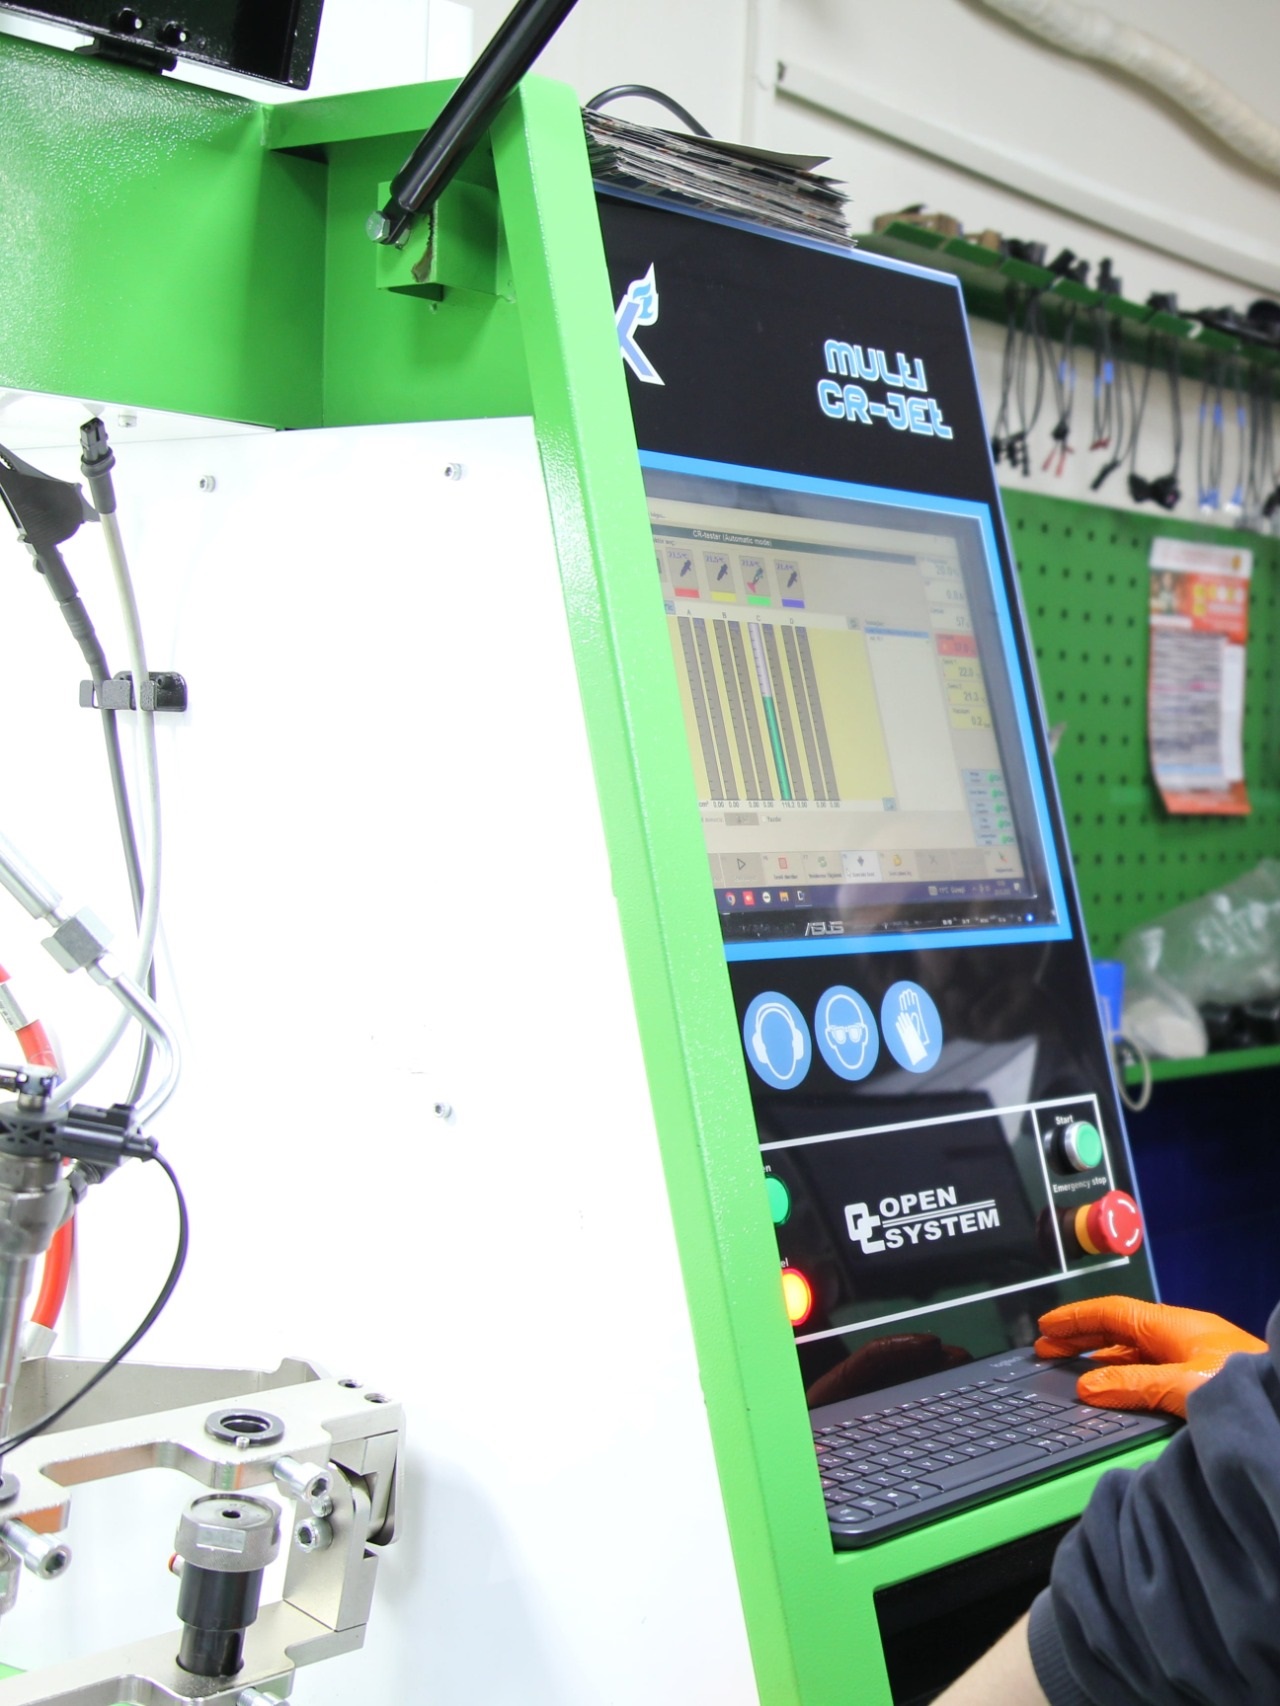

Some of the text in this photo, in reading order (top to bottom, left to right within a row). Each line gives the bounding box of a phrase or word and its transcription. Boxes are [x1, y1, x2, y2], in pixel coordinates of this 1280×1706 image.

[805, 921, 845, 937] ASUS
[1055, 1114, 1074, 1126] Start
[1052, 1176, 1107, 1194] Emergency stop
[879, 1186, 958, 1218] OPEN
[885, 1208, 1000, 1249] SYSTEM
